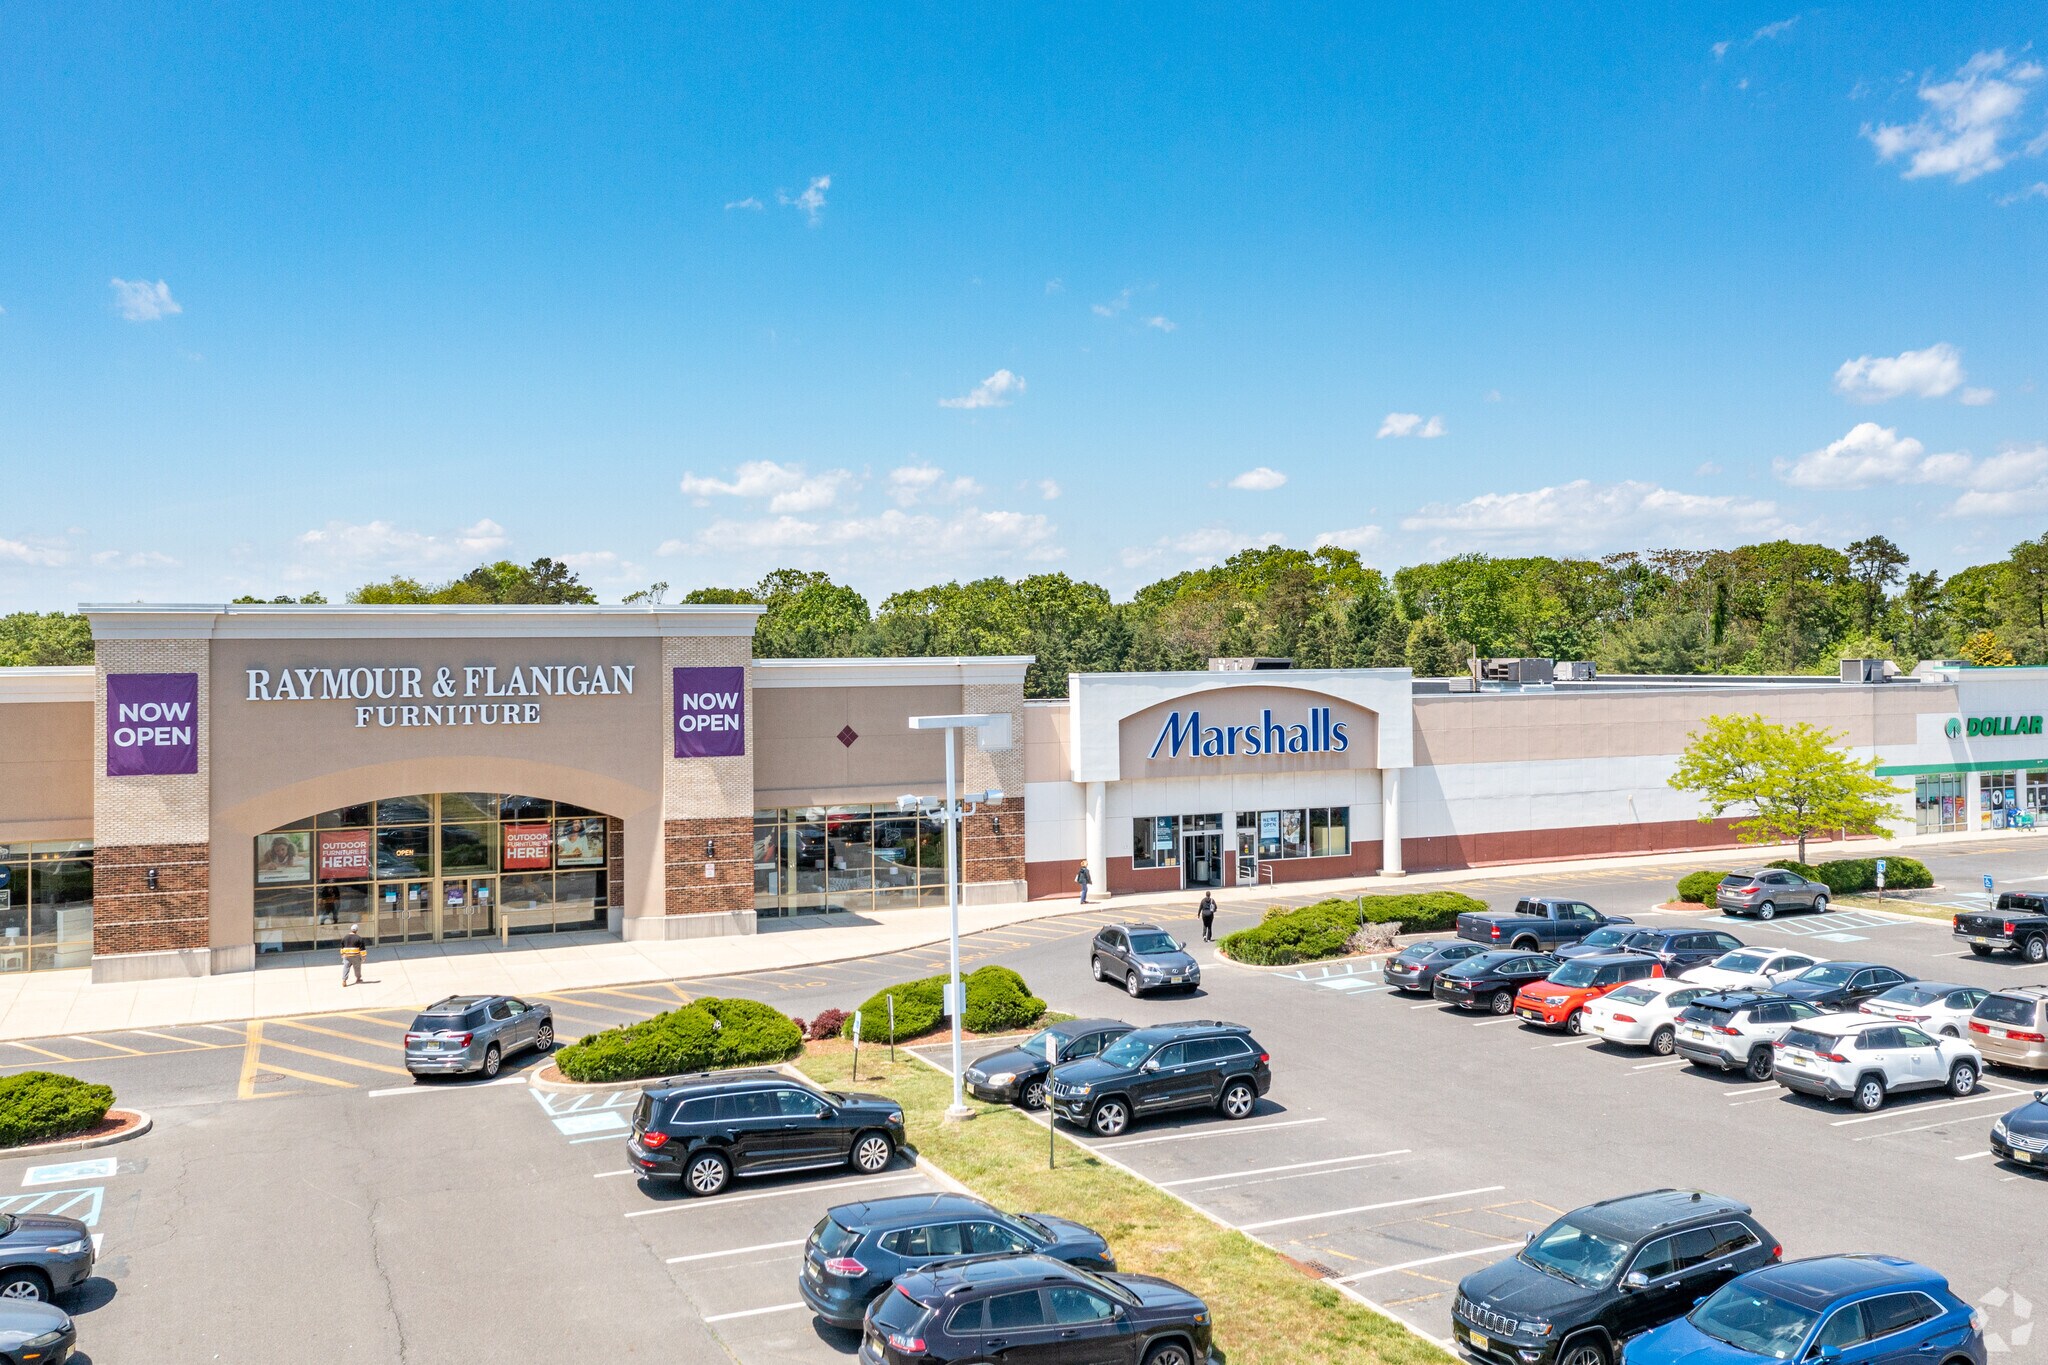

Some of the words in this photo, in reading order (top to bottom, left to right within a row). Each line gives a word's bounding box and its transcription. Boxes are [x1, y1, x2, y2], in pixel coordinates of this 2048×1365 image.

[246, 666, 424, 701] RAYMOUR
[431, 666, 457, 698] &
[463, 664, 636, 697] FLANIGAN
[682, 692, 739, 711] NOW
[119, 702, 191, 723] NOW
[355, 702, 541, 728] FURNITURE
[679, 713, 739, 732] OPEN
[1967, 715, 2043, 737] DOLLAR
[113, 726, 191, 747] OPEN
[1146, 706, 1349, 760] Marshalls
[322, 841, 367, 850] OUTDOOR
[507, 833, 548, 841] OUTDOOR
[322, 855, 367, 869] HERE!
[396, 849, 414, 857] OPEN
[507, 846, 548, 859] HERE!
